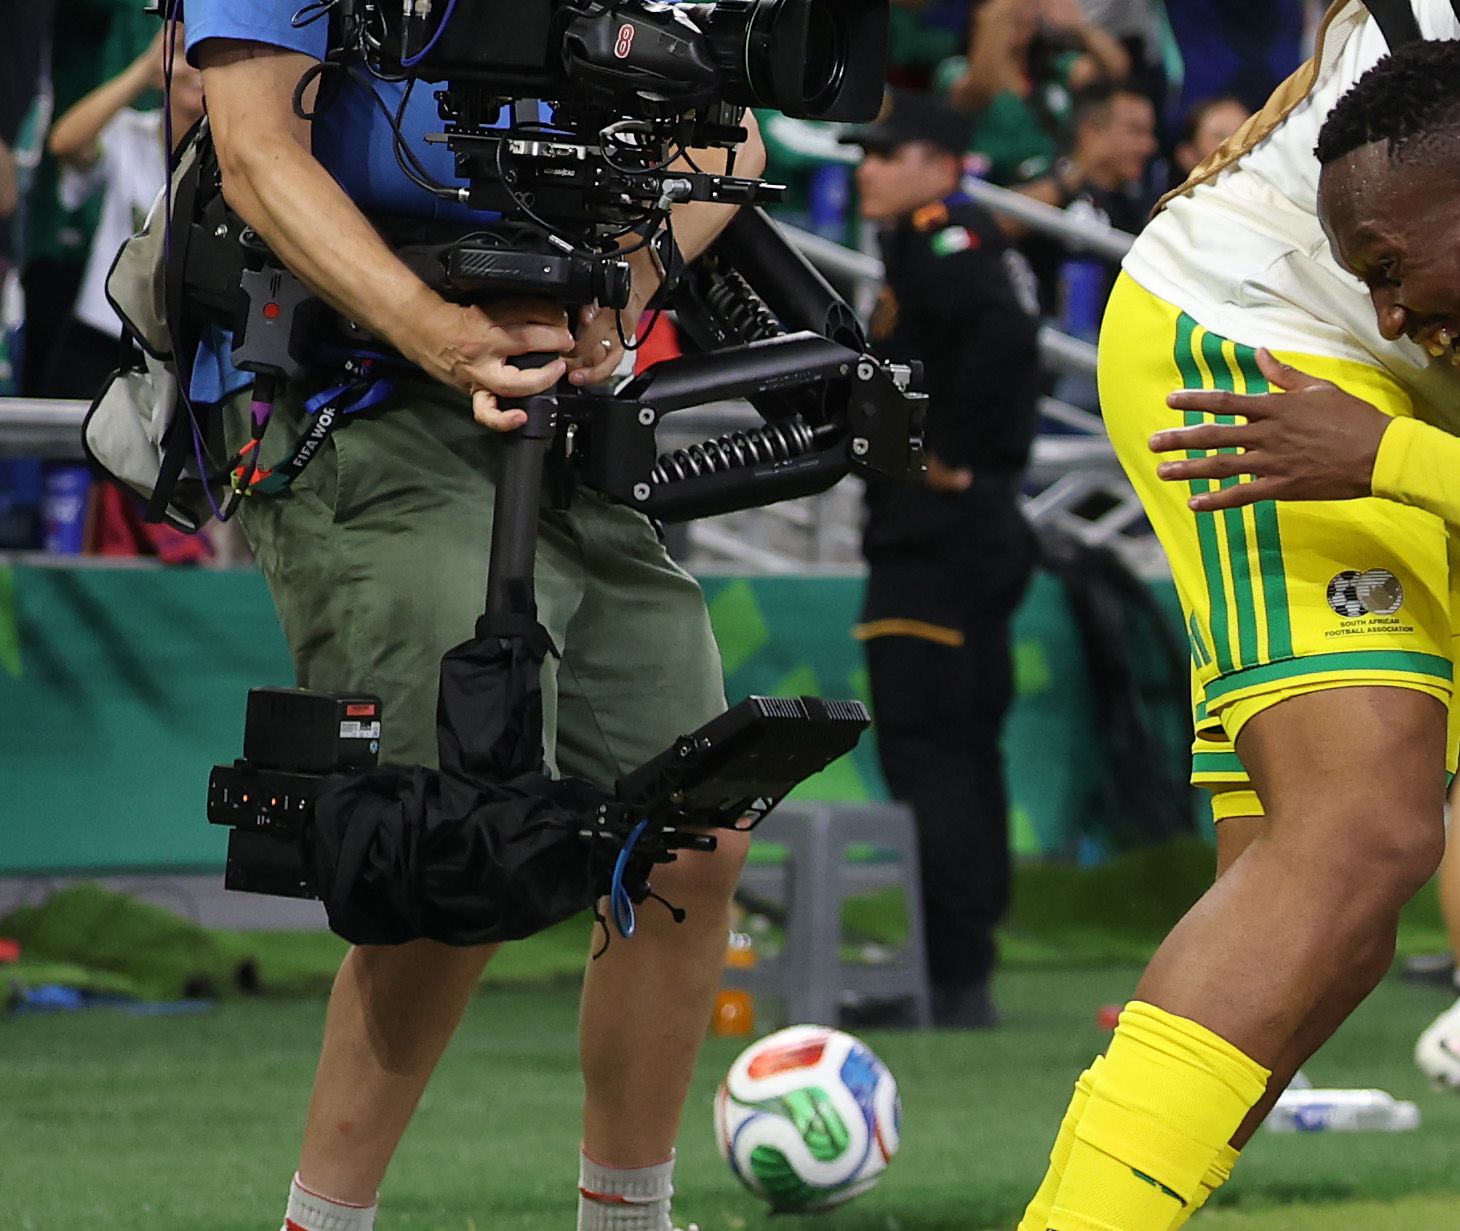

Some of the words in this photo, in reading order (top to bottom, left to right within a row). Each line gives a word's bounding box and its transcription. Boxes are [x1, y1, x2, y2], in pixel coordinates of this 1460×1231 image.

[614, 23, 635, 59] 8
[293, 440, 319, 467] FIFA
[1325, 628, 1364, 637] FOOTBALL
[1340, 619, 1366, 628] SOUTH
